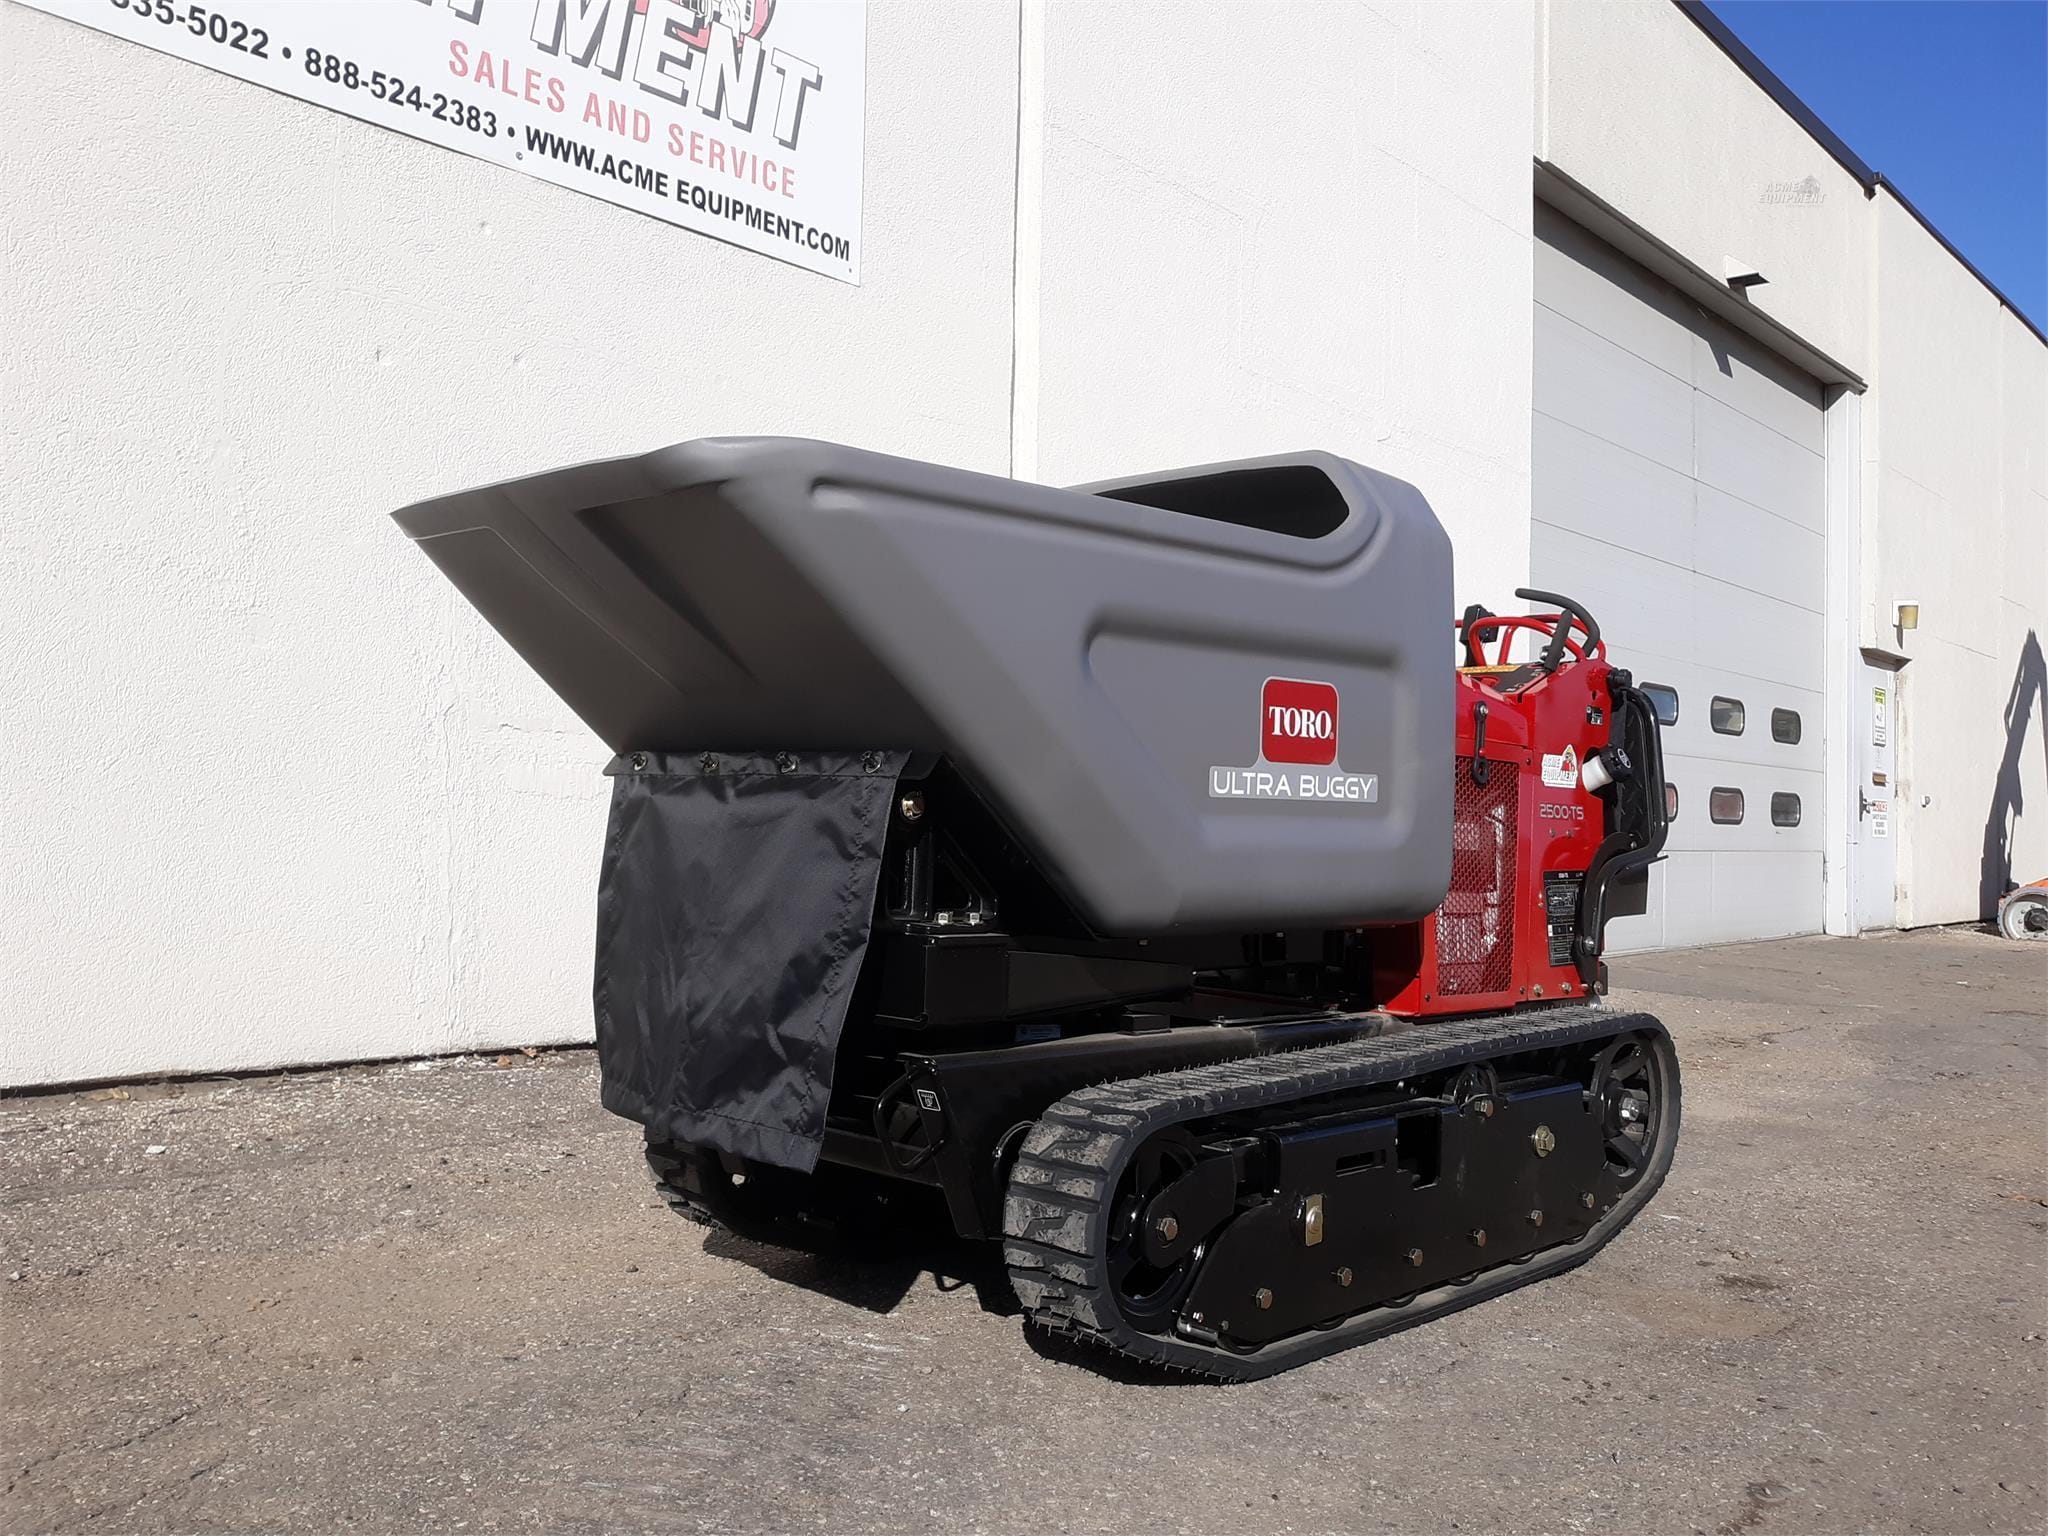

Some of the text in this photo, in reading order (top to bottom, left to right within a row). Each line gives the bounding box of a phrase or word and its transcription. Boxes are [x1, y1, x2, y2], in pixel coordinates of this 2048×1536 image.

[304, 48, 498, 138] 888-524-2383
[525, 126, 669, 198] WWW.ACME
[676, 180, 851, 262] EQUIPMENT.COM
[449, 40, 796, 199] SALES AND SERVICE
[1269, 706, 1332, 739] TORO
[1213, 770, 1373, 800] ULTRA BUGGY
